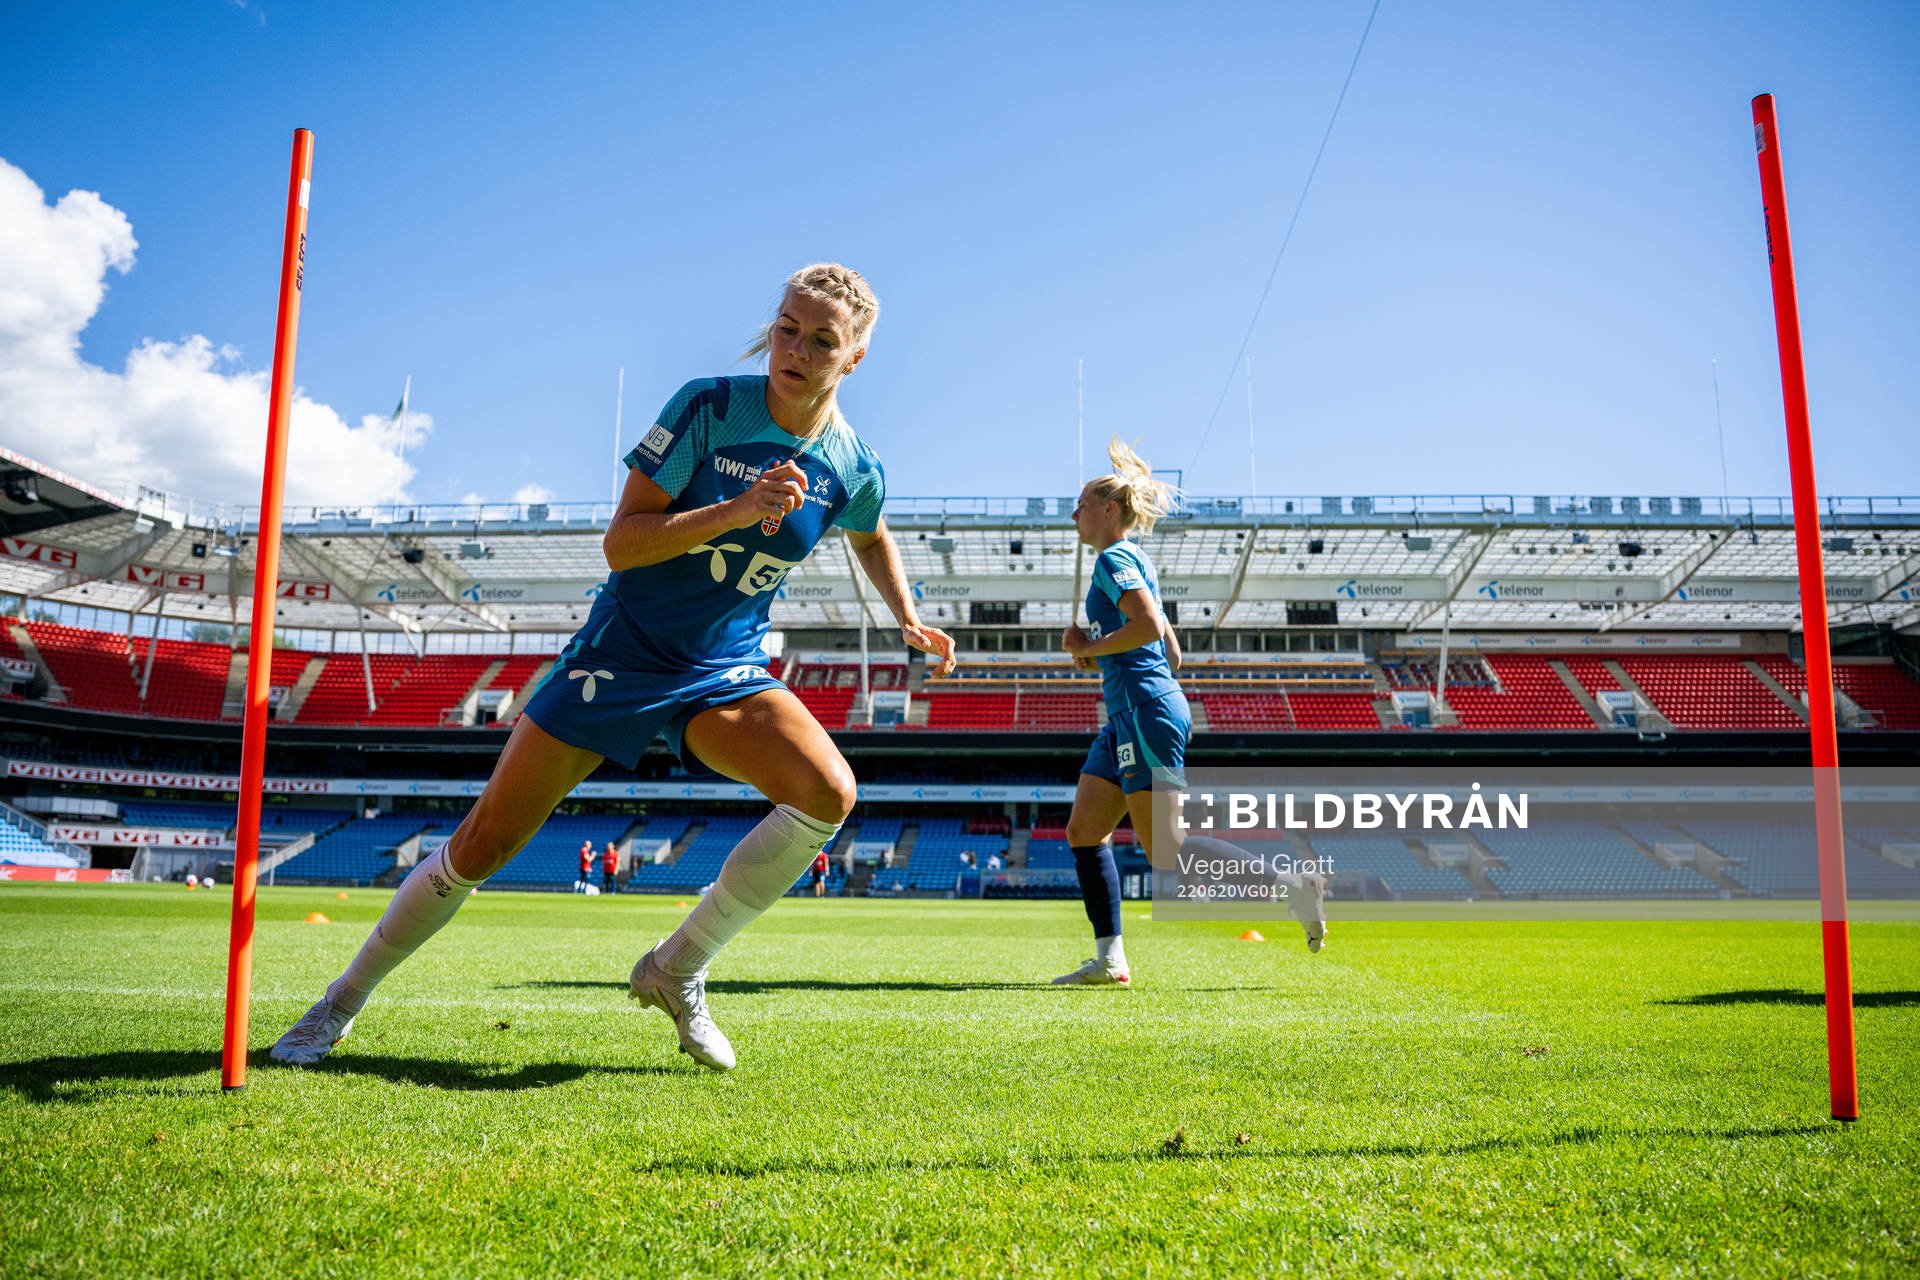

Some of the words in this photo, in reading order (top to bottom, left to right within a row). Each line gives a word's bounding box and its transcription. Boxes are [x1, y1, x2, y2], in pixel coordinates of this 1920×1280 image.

[714, 455, 746, 479] KIWI
[803, 493, 817, 503] orsk
[0, 537, 77, 569] VG
[128, 564, 204, 591] VG
[397, 588, 438, 599] telenor
[481, 587, 524, 599] telenor
[788, 585, 832, 597] telenor
[925, 585, 970, 597] telenor
[1160, 586, 1190, 596] enor
[1357, 584, 1402, 596] telenor
[1499, 584, 1543, 596] telenor
[1688, 585, 1732, 597] telenor
[1825, 585, 1863, 597] elenor
[11, 762, 54, 778] VG
[58, 765, 101, 781] VG
[104, 768, 147, 784] VG
[55, 828, 99, 841] VG
[113, 831, 159, 844] VG
[174, 833, 219, 847] VG
